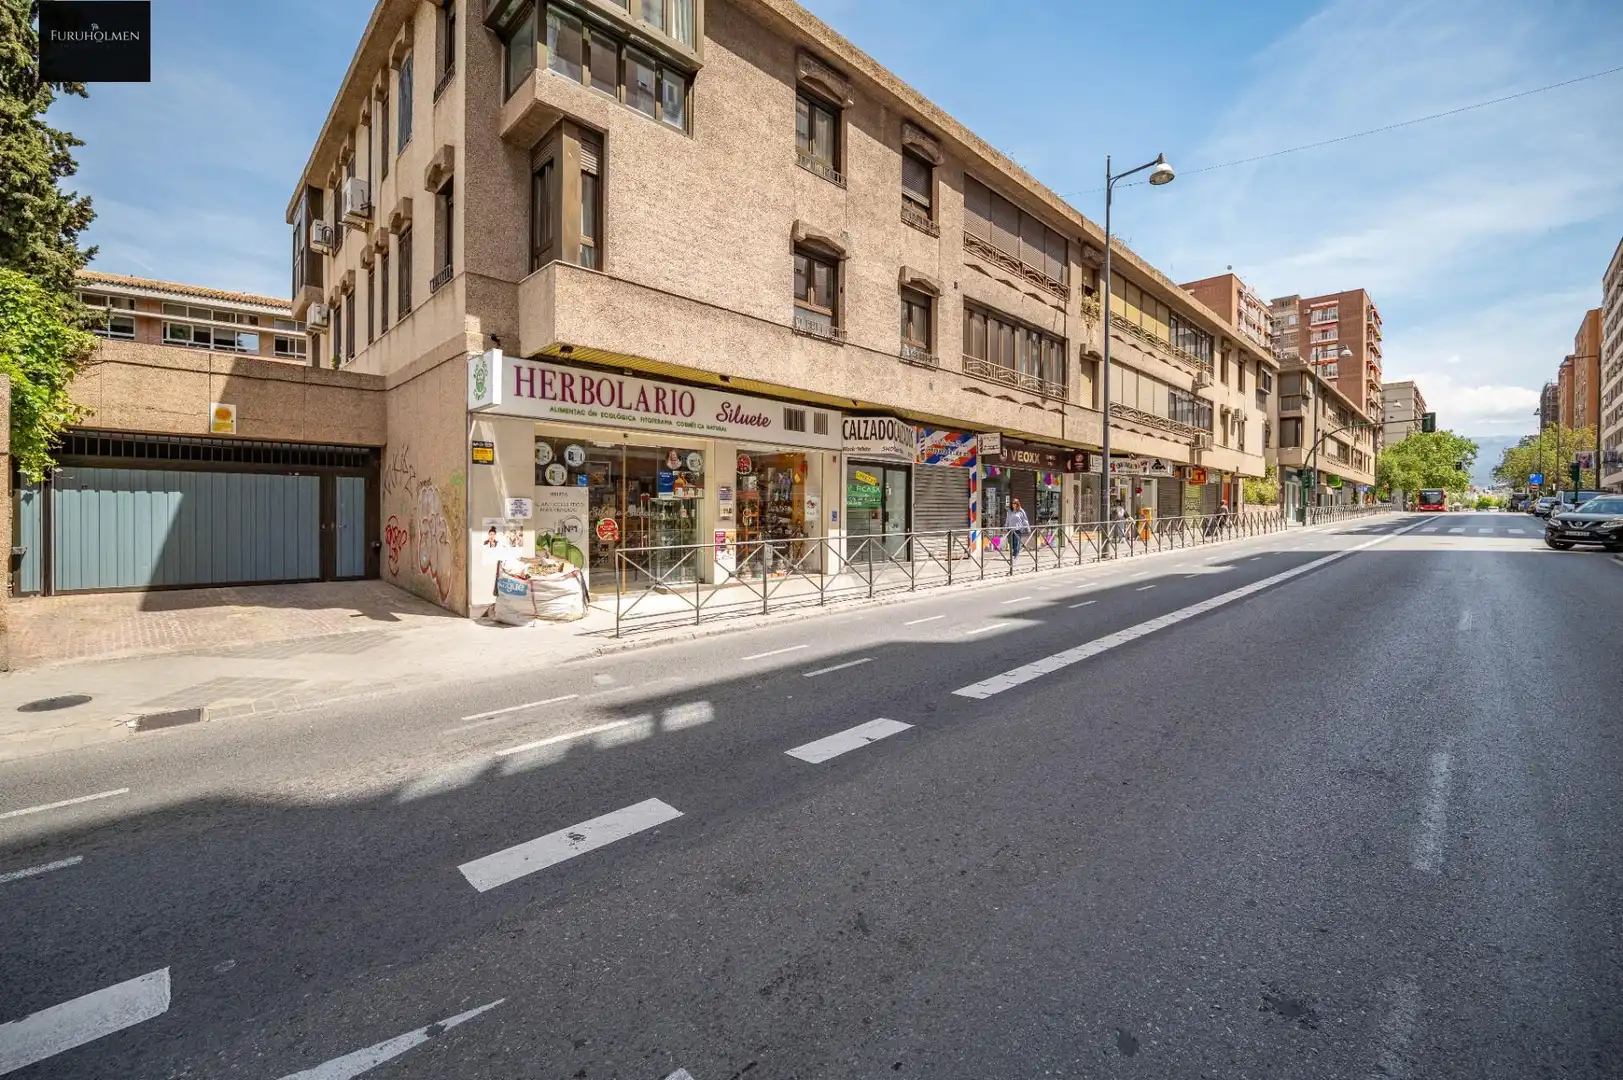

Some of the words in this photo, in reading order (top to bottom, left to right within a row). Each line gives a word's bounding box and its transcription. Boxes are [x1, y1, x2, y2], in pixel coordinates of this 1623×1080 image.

[513, 365, 695, 418] HERBOLARIO
[716, 401, 772, 428] Siluete
[1010, 449, 1041, 465] VEOXX
